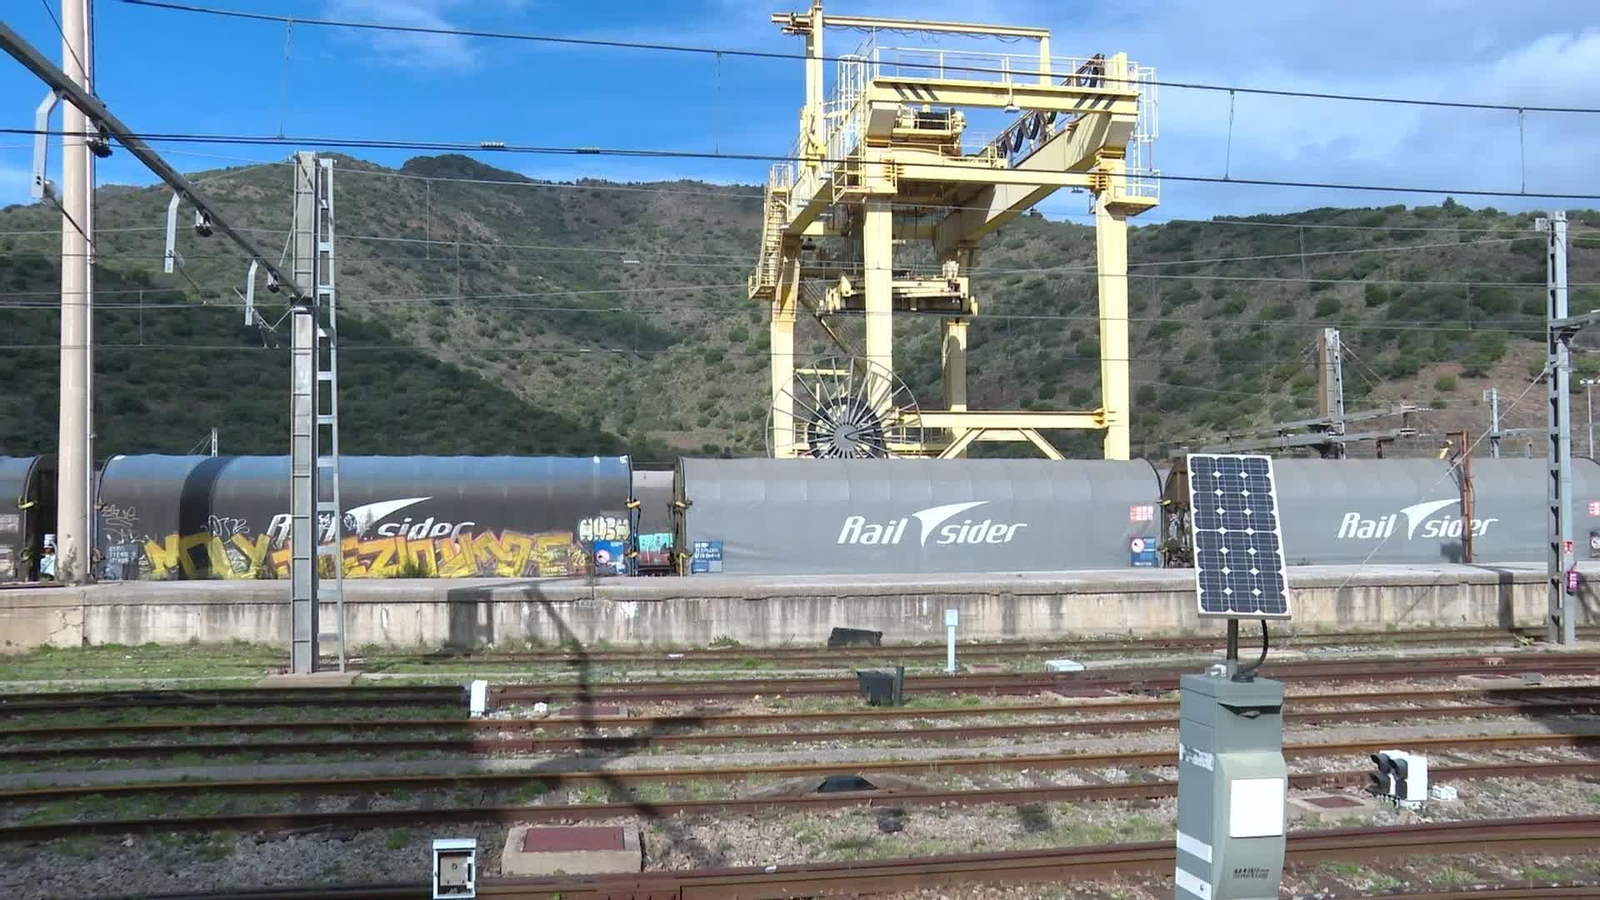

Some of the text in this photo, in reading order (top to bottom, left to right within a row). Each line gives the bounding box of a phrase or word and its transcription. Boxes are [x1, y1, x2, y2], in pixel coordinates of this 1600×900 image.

[837, 505, 1028, 545] Rail sider
[1337, 511, 1398, 539] Rail
